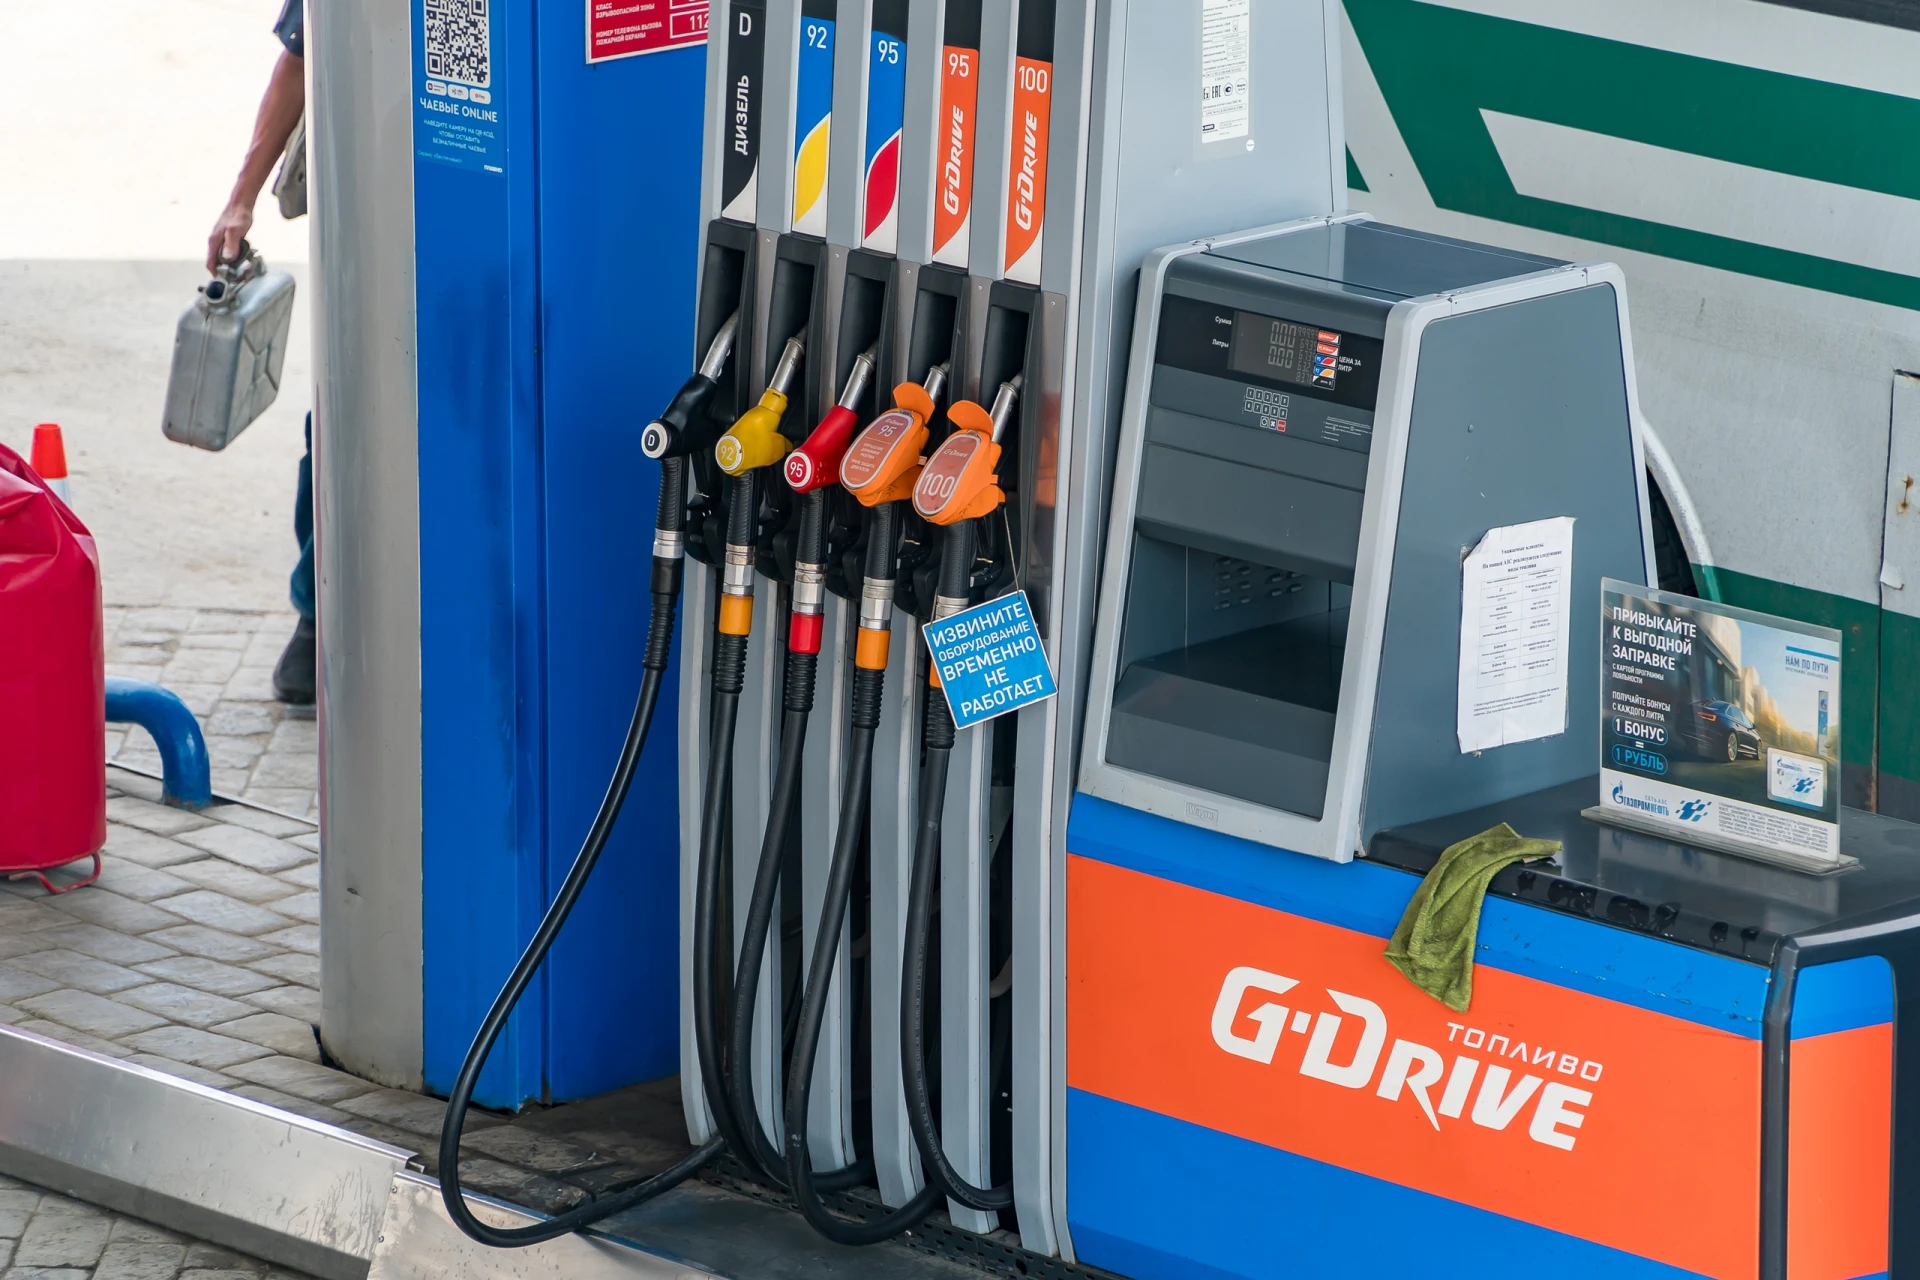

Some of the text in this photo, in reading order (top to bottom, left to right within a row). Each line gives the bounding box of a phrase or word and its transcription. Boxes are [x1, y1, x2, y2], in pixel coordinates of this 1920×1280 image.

[596, 3, 612, 11] КЛАСС
[596, 3, 655, 19] ВЗРЫВООПАСНОЙ ЗОНЫ
[596, 21, 663, 38] НОМЕР ТЕЛЕФОНА ВЫЗОВА
[739, 12, 752, 36] D
[596, 32, 646, 46] ПОЖАРНОЙ ОХРАНЫ
[807, 24, 828, 49] 92
[878, 40, 899, 64] 95
[949, 53, 970, 78] 95
[1018, 65, 1048, 94] 100
[420, 97, 498, 122] ЧАЕВЫЕ ONLINE
[735, 75, 750, 156] ДИЗЕЛЬ
[424, 119, 448, 129] НАВЕДИТЕ
[449, 123, 467, 132] КАМЕРУ
[439, 131, 481, 144] ЧТОБЫ ОСТАВИТЬ
[1215, 315, 1232, 326] Сумма
[1212, 338, 1229, 348] Литры
[1337, 364, 1353, 372] ЛИТР
[1339, 356, 1362, 367] ЦЕНА ЗА
[648, 434, 656, 447] D
[878, 425, 897, 437] 95
[721, 446, 734, 460] 92
[790, 461, 804, 478] 95
[922, 472, 956, 499] 100
[932, 601, 1026, 648] ИЗВИНИТЕ
[1613, 606, 1697, 638] ПРИВЫКАЙТЕ
[938, 620, 1031, 662] ОБОРУДОВАНИЕ
[1613, 625, 1692, 656] К ВЫГОДНОЙ
[942, 635, 1037, 681] ВРЕМЕННО
[1612, 645, 1676, 671] ЗАПРАВКЕ
[1785, 656, 1829, 674] НАМ ПО ПУТИ
[984, 666, 1010, 688] НЕ
[1612, 671, 1643, 684] ЛОЯЛЬНОСТИ
[1616, 664, 1635, 673] КАРТОЙ
[1635, 668, 1664, 681] ПРОГРАММЫ
[961, 674, 1043, 718] РАБОТАЕТ
[1612, 691, 1671, 712] ПОЛУЧАЙТЕ БОНУСЫ
[1612, 702, 1665, 722] С КАЖДОГО ЛИТРА
[1615, 718, 1665, 742] 1 БОНУС
[1615, 747, 1664, 771] 1 РУБЛЬ
[1446, 1021, 1604, 1083] ТОПЛИВО
